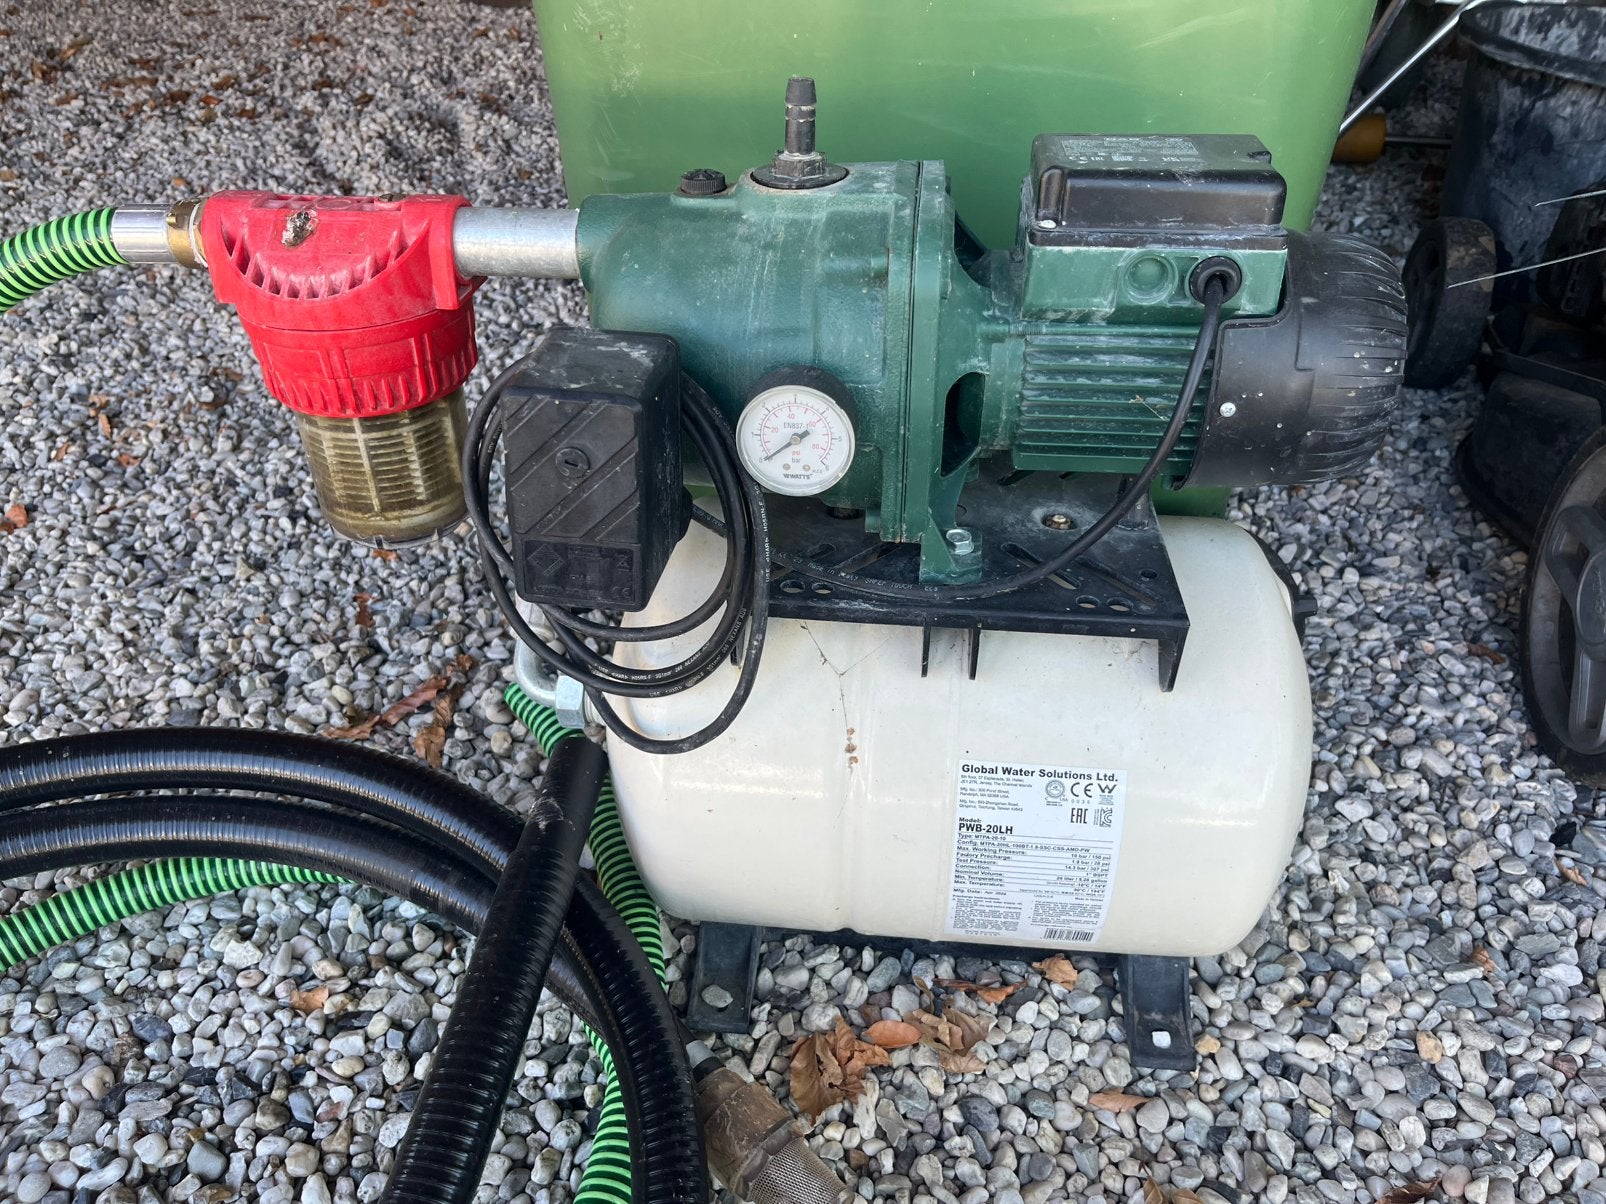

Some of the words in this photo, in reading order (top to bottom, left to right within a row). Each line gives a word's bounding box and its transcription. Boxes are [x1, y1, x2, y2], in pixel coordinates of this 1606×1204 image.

[962, 764, 998, 775] Global
[1002, 767, 1035, 777] Water
[1039, 769, 1092, 780] Solutions
[1096, 772, 1118, 782] Ltd.
[1070, 807, 1088, 824] EAC
[959, 822, 1013, 834] PWB-20LH
